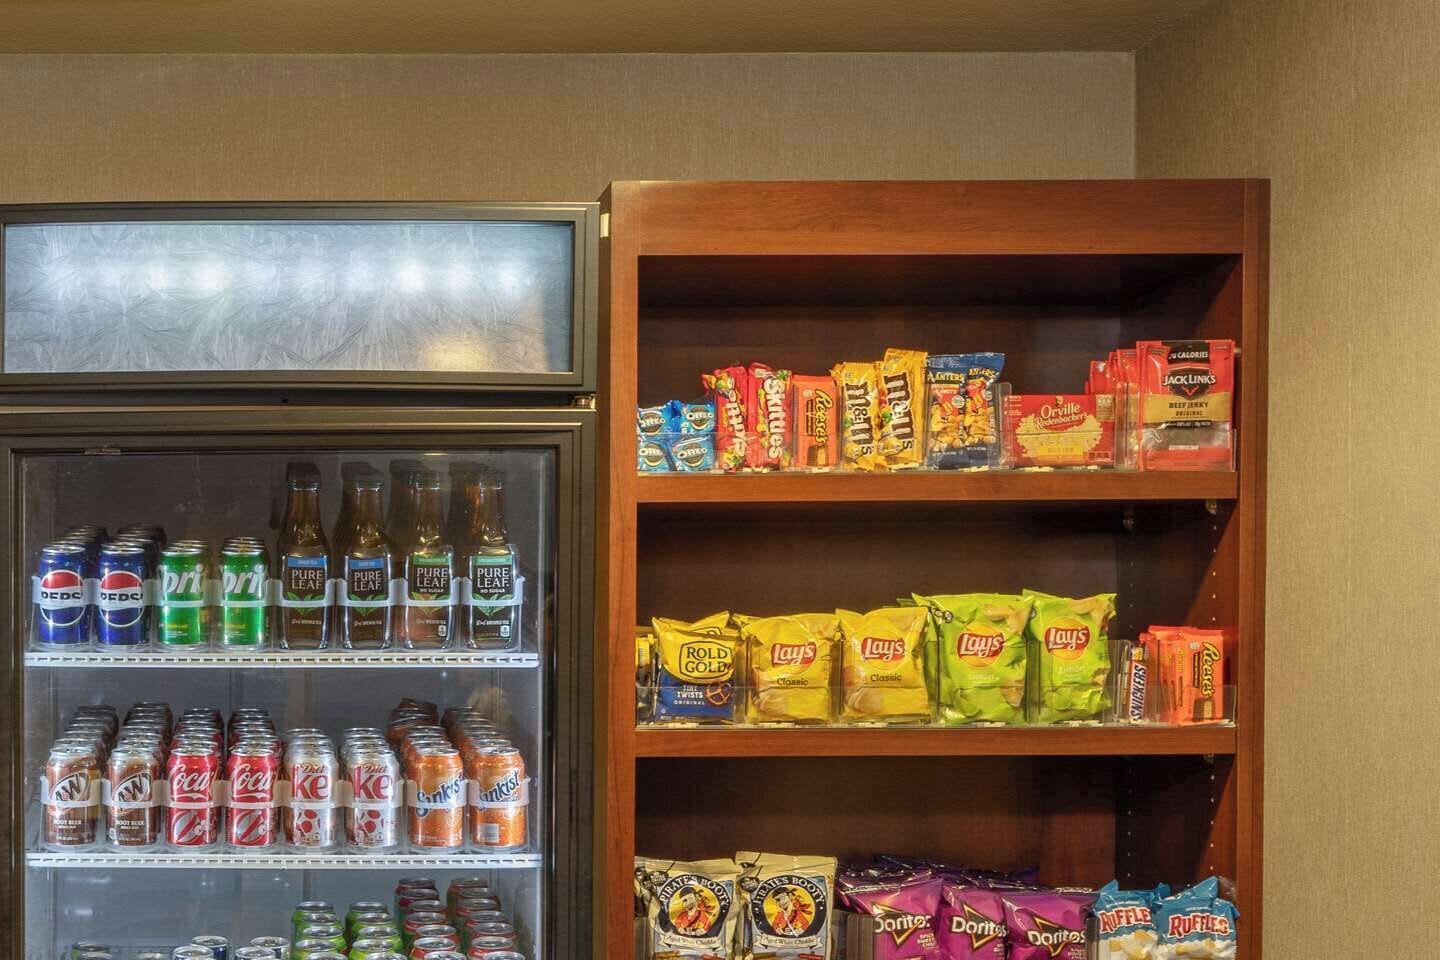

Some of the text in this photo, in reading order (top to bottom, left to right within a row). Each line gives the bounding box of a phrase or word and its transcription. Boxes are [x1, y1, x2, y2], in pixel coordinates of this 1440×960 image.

[1177, 351, 1208, 359] CALORIES
[1164, 375, 1187, 385] JACK
[815, 390, 833, 444] Reese's
[1041, 402, 1080, 418] Orville
[764, 378, 784, 458] Skittles
[292, 569, 323, 580] PURE
[354, 571, 382, 581] PURE
[417, 568, 448, 578] PURE
[477, 568, 509, 578] PURE
[292, 580, 323, 589] LEAF
[354, 581, 382, 591] LEAF
[417, 578, 447, 587] LEAF
[477, 578, 508, 588] LEAF
[41, 592, 80, 600] PEPS
[960, 634, 1002, 657] Lay's
[1049, 628, 1088, 650] Lay's
[687, 647, 727, 659] ROLD
[774, 643, 814, 666] Lay's
[864, 639, 904, 661] Lay's
[686, 661, 727, 673] GOLD
[1201, 642, 1220, 696] Reese's
[777, 677, 808, 686] Classic
[1130, 664, 1146, 722] SNICKERS
[701, 878, 728, 906] BOOTY
[792, 876, 825, 904] BOOTY
[952, 916, 1007, 937] Doritos
[1100, 907, 1150, 932] RUFFLE
[1169, 913, 1228, 936] RUFFLES
[1029, 931, 1085, 946] Doritos
